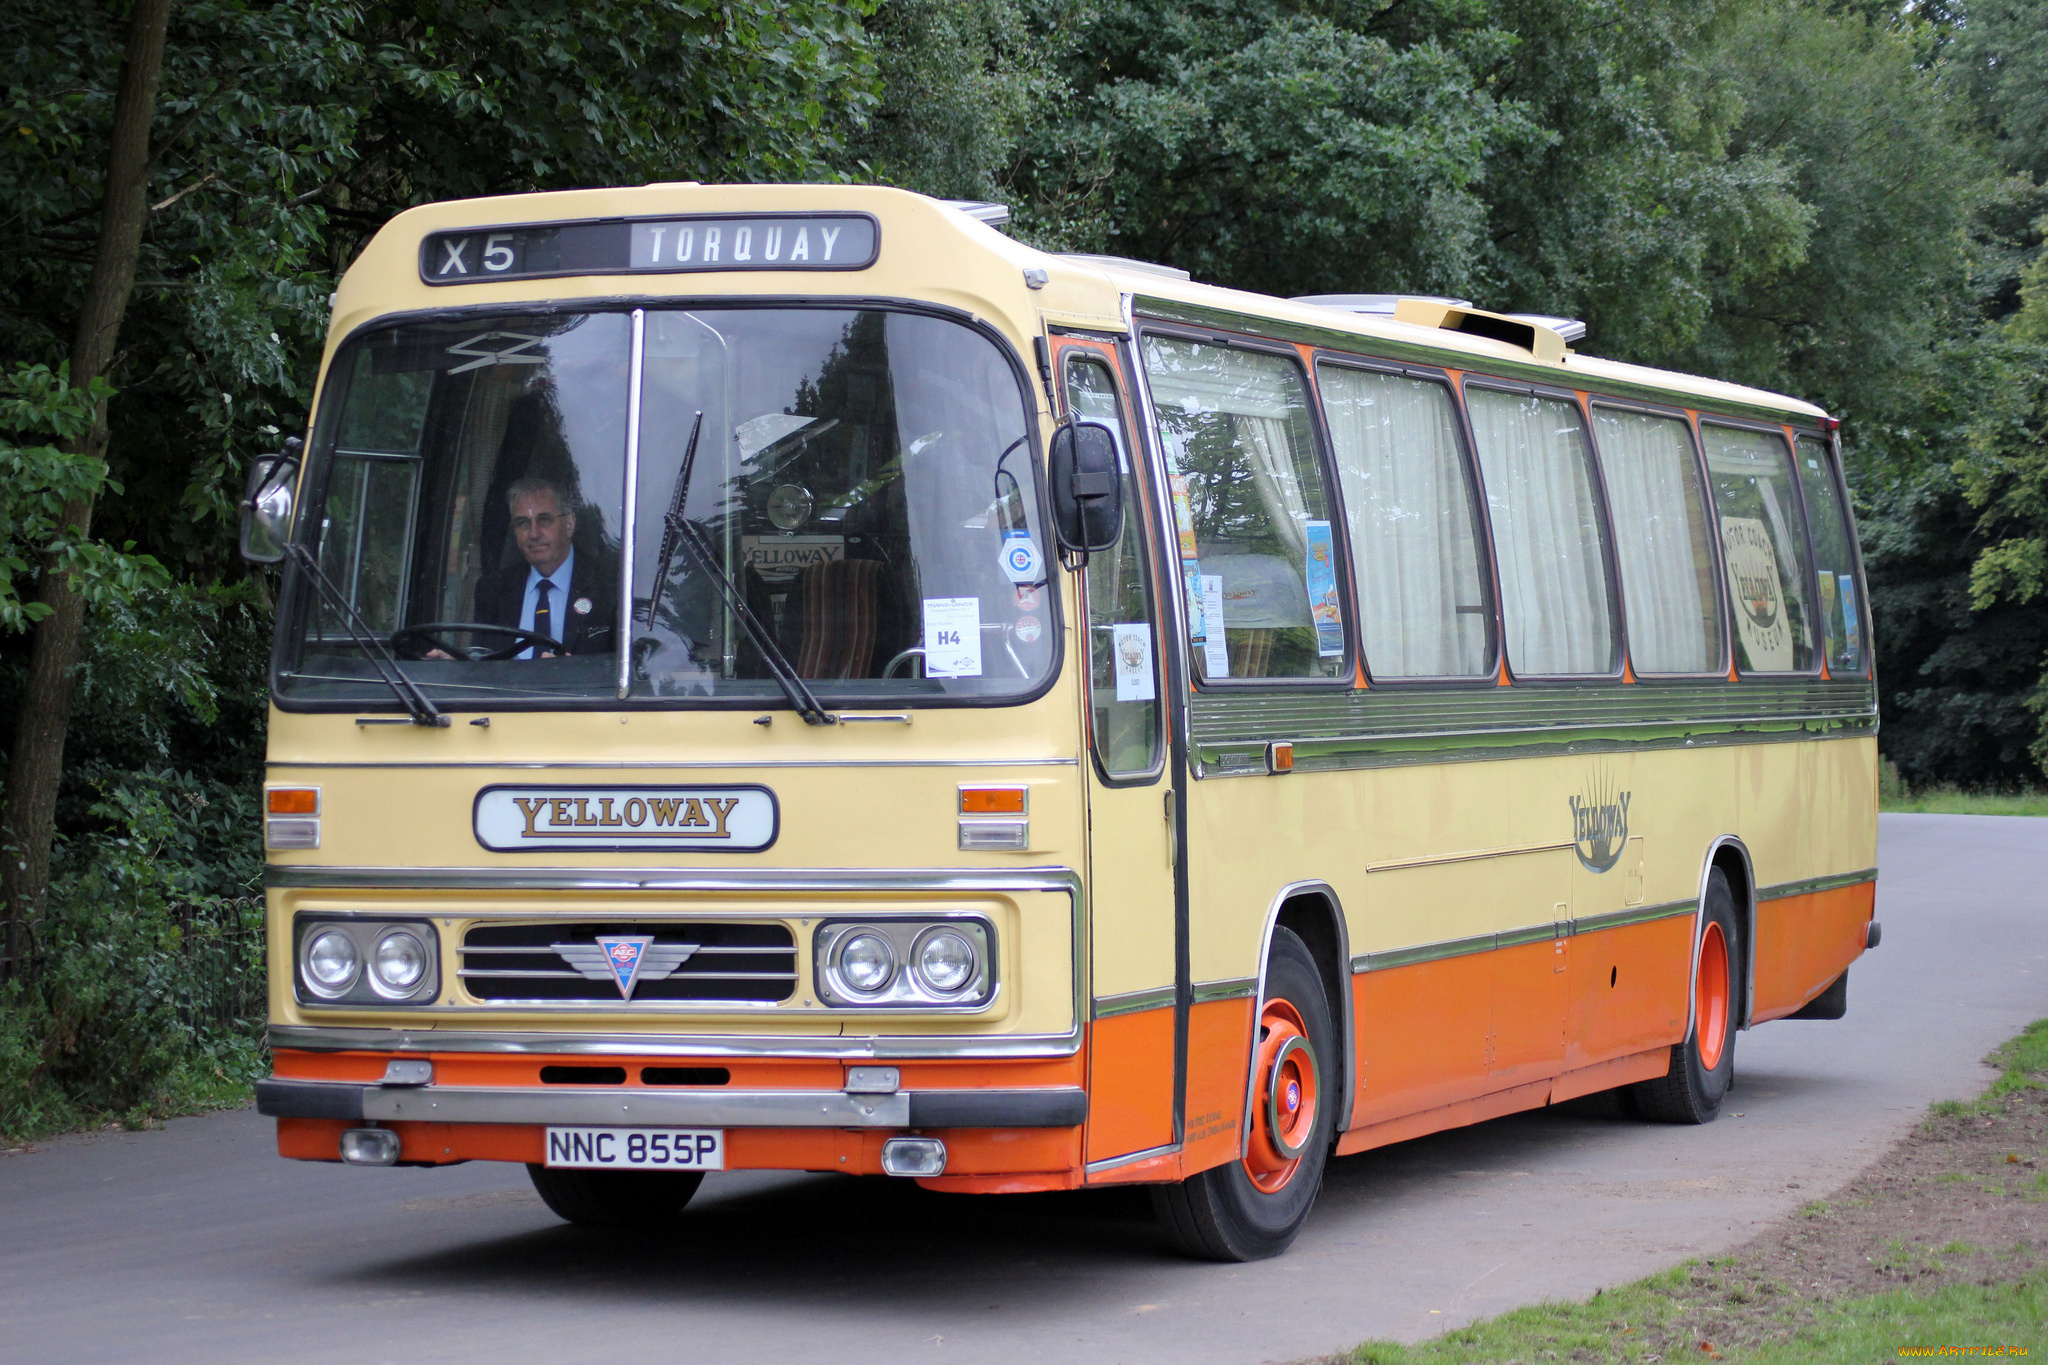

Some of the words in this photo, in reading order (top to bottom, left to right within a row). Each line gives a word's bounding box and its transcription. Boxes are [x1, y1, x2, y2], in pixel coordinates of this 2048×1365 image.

[649, 225, 843, 264] TORQUAY
[742, 546, 840, 564] YELLOWAY
[938, 630, 961, 645] H4
[512, 797, 740, 839] YELLOWAY
[1568, 791, 1632, 842] YELLOWAY
[550, 1131, 617, 1163] NNC
[627, 1133, 717, 1165] 855P
